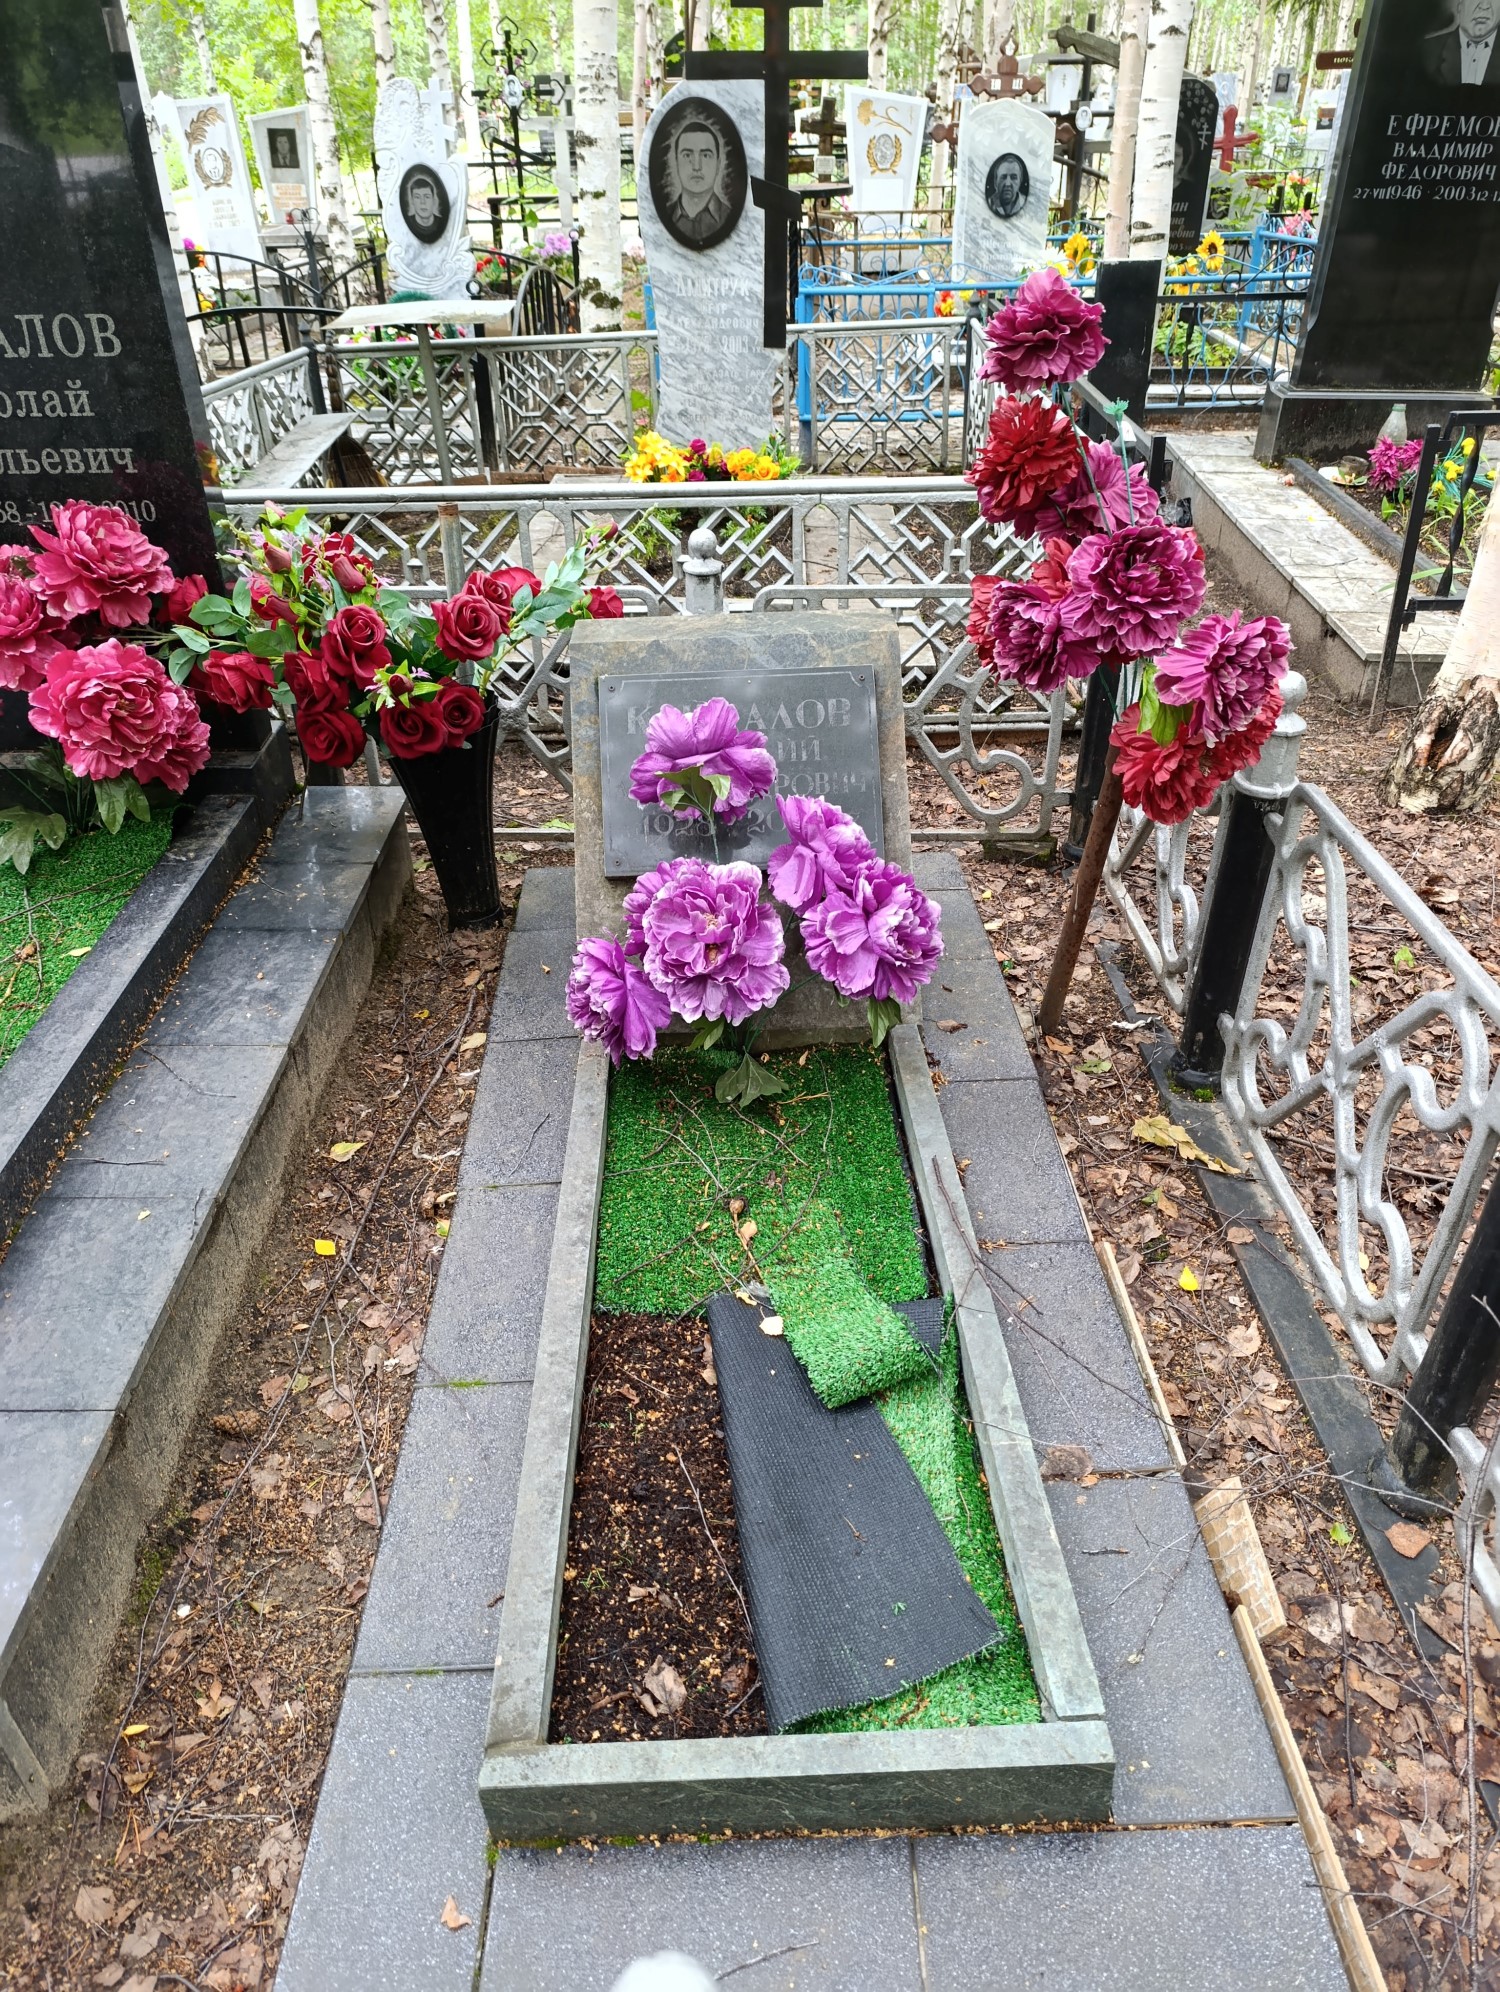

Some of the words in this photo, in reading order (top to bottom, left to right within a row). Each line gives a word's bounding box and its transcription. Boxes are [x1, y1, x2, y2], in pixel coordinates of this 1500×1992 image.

[1393, 141, 1494, 160] ВЛАДИМИР
[1381, 162, 1497, 182] ФЕДОРОВИЧ
[1433, 185, 1476, 201] 2003
[676, 275, 750, 297] ДМИТРУК
